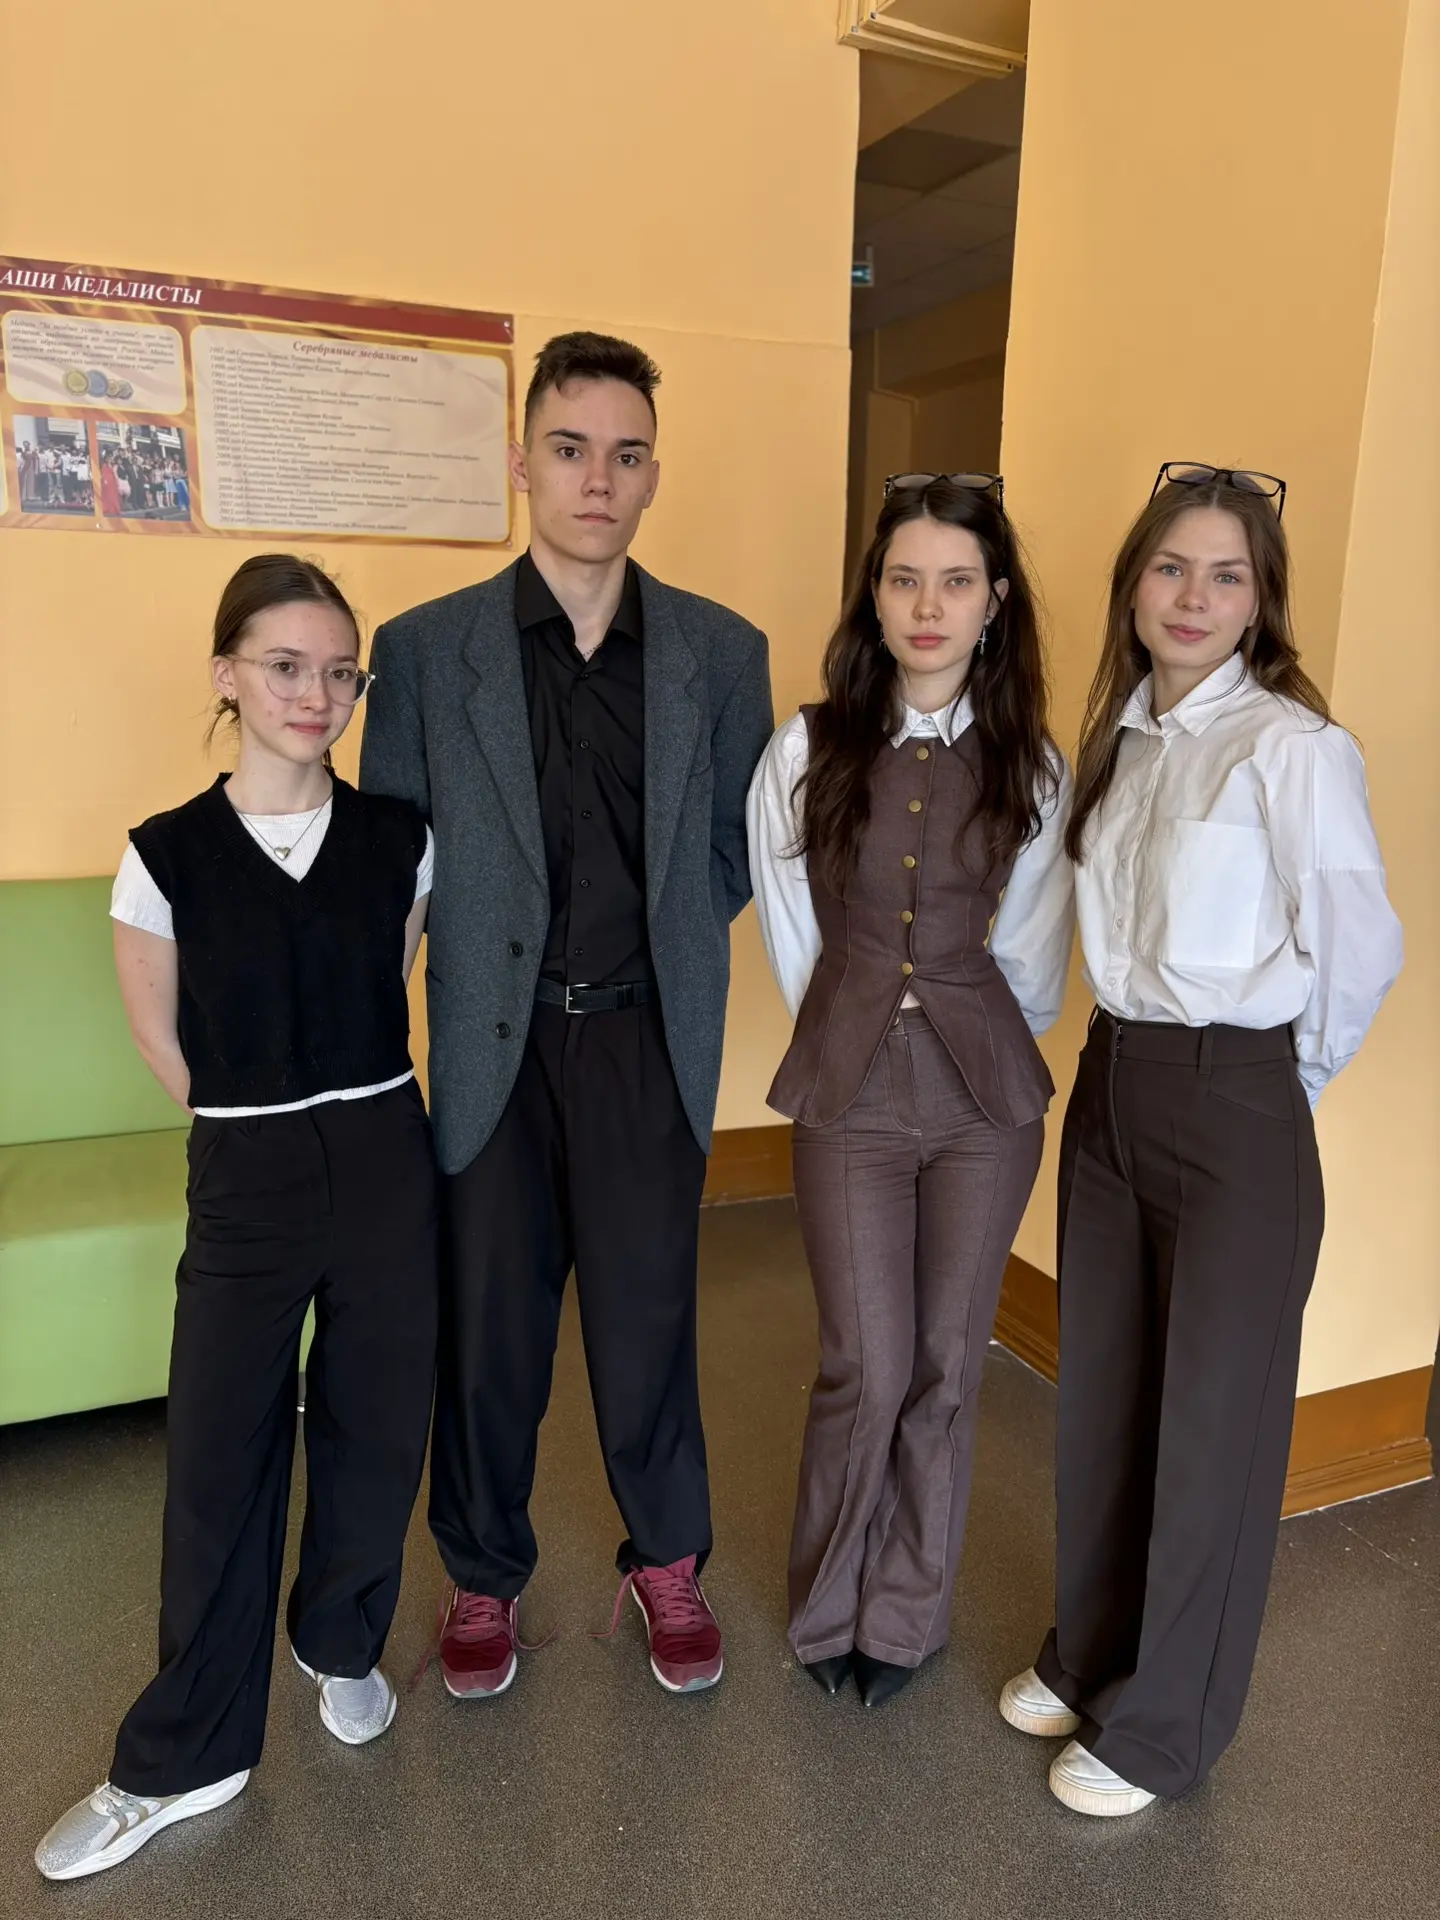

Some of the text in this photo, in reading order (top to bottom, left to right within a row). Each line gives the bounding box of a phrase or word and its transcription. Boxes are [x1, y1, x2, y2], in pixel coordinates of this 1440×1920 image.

[0, 269, 203, 305] АШИ МЕДАЛИСТЫ
[293, 341, 356, 357] Серебряные
[358, 350, 418, 363] медалисты
